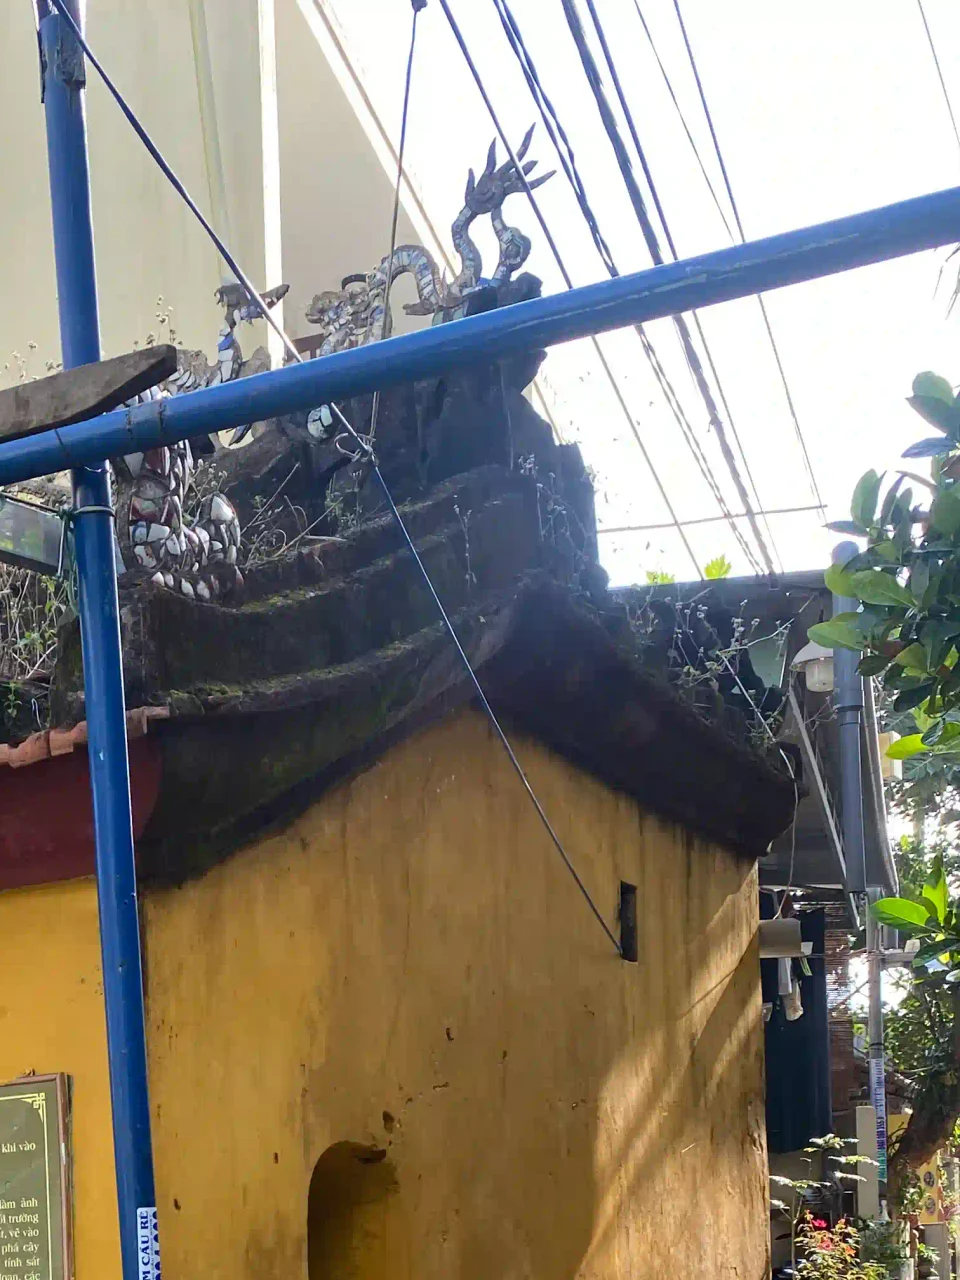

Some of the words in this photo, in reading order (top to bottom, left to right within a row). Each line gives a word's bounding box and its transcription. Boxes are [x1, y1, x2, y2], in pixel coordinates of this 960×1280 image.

[2, 1142, 16, 1153] khi
[19, 1141, 36, 1151] vào
[0, 1201, 15, 1209] làm
[20, 1198, 38, 1208] ảnh
[8, 1212, 38, 1225] trường
[9, 1228, 20, 1236] vẽ
[23, 1227, 39, 1236] vào
[1, 1243, 19, 1254] phá
[23, 1242, 40, 1253] cây
[5, 1257, 22, 1268] tính
[26, 1256, 40, 1266] sát
[24, 1272, 40, 1280] các
